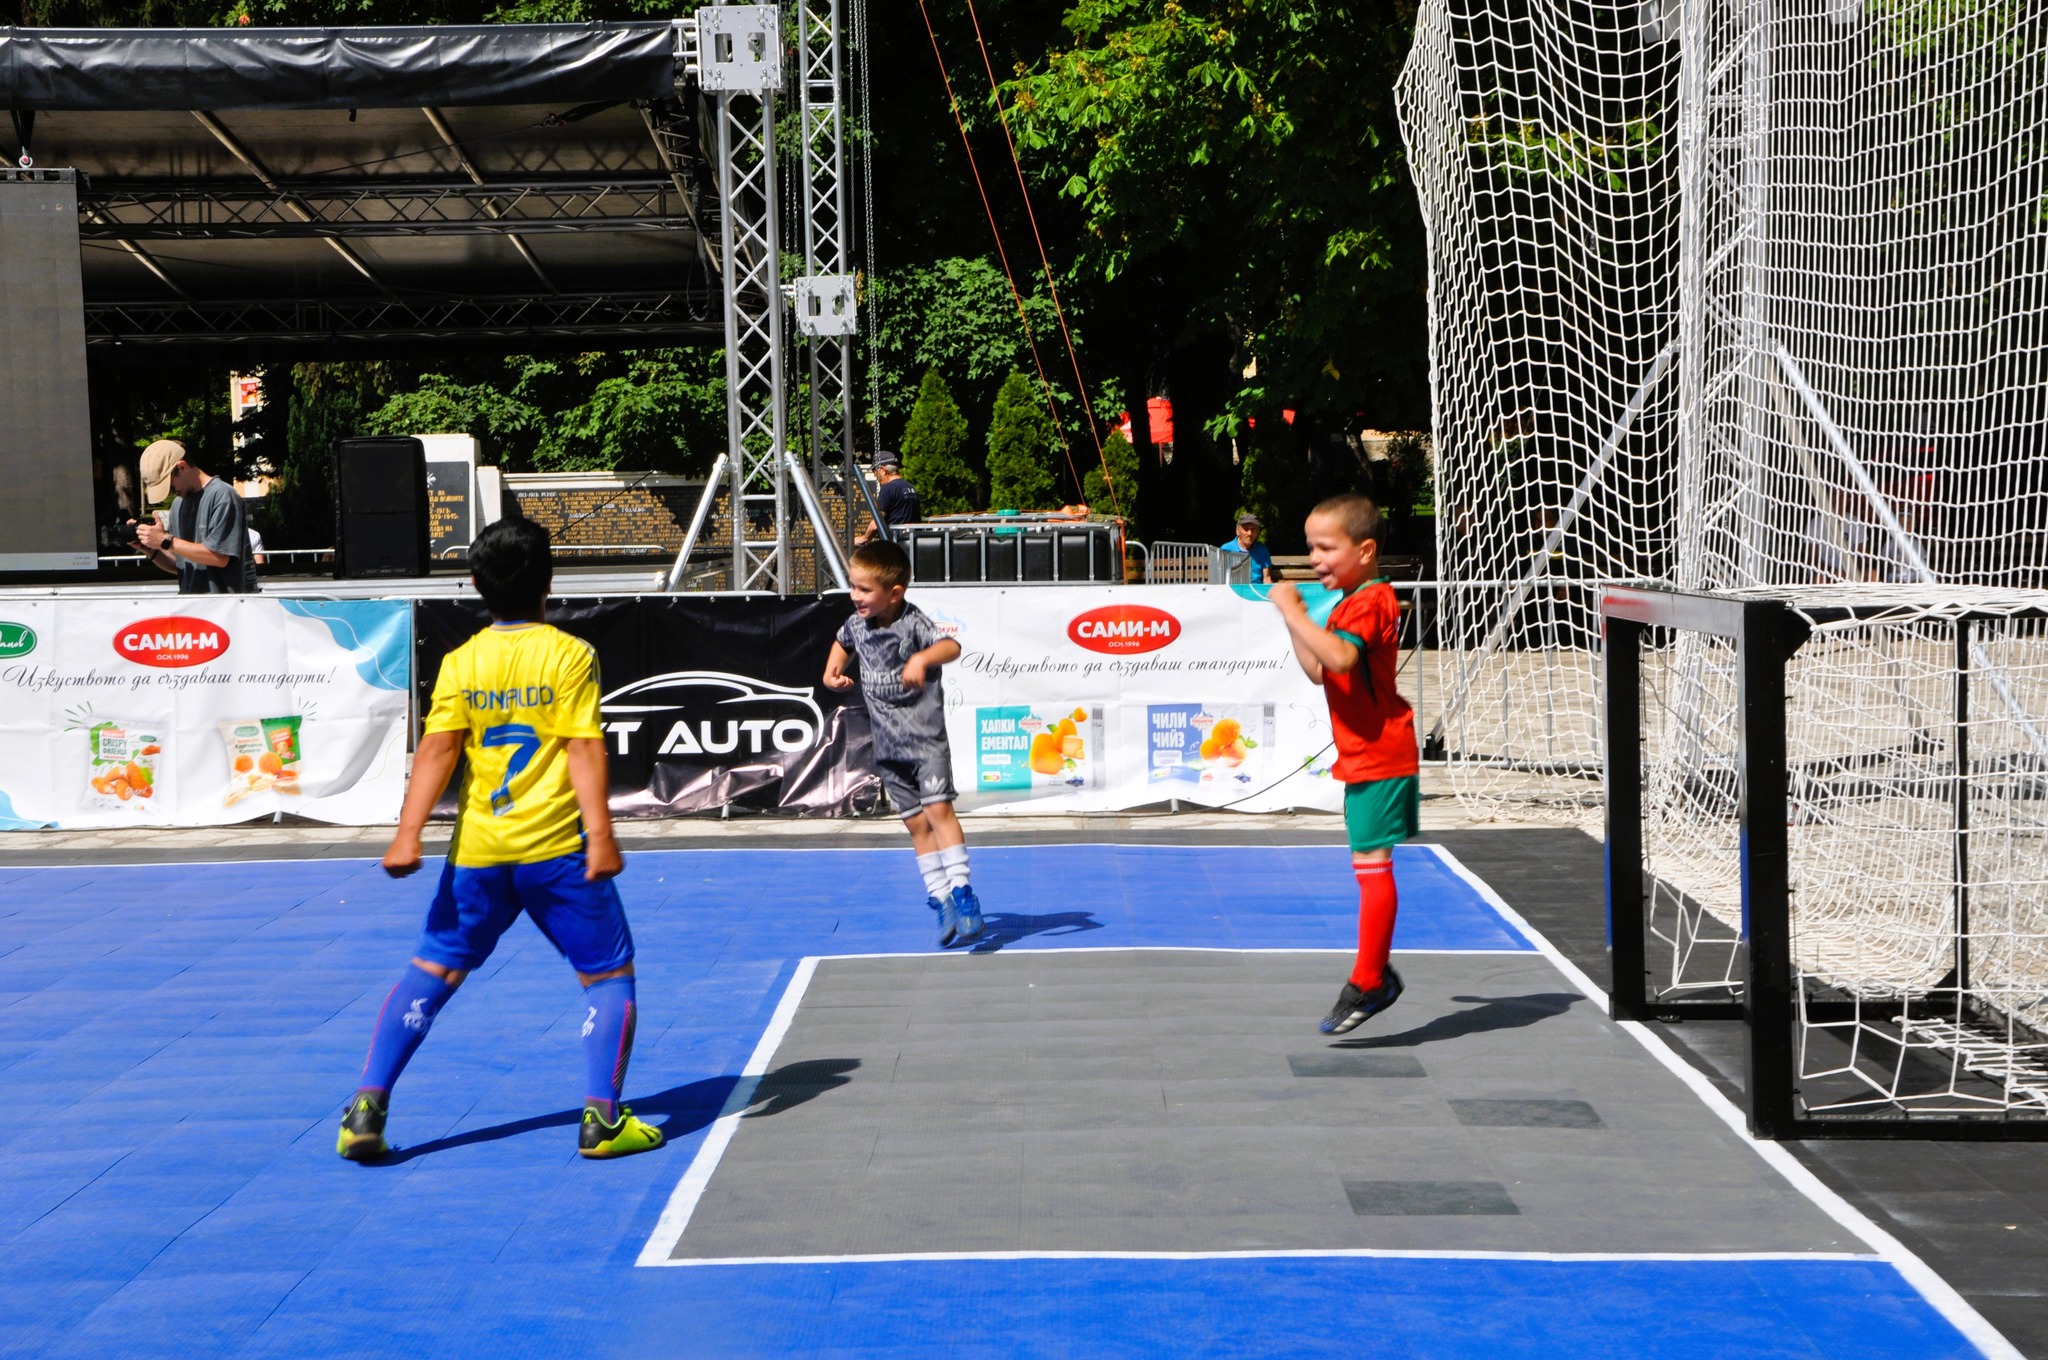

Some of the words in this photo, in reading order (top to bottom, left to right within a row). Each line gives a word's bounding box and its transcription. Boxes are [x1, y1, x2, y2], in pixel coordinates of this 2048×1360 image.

[1077, 620, 1171, 638] САМИ-М
[123, 632, 219, 651] САМИ-М
[156, 653, 189, 661] ОСН.1996
[960, 651, 1079, 679] Изкуството
[1082, 661, 1103, 678] да
[1108, 653, 1182, 677] създаваш
[1188, 650, 1290, 675] стандарти!
[2, 665, 126, 693] Изкуството
[130, 675, 152, 691] да
[157, 666, 233, 690] създаваш
[238, 665, 337, 689] стандарти!
[461, 685, 554, 710] RONALDO
[981, 718, 1016, 734] ХАПКИ
[1152, 712, 1187, 729] ЧИЛИ
[102, 738, 128, 747] CRISPY
[657, 719, 814, 754] AUTO
[981, 735, 1028, 751] ЕМЕНТАЛ
[1152, 728, 1186, 748] ЧИЙЗ
[481, 723, 543, 817] 7
